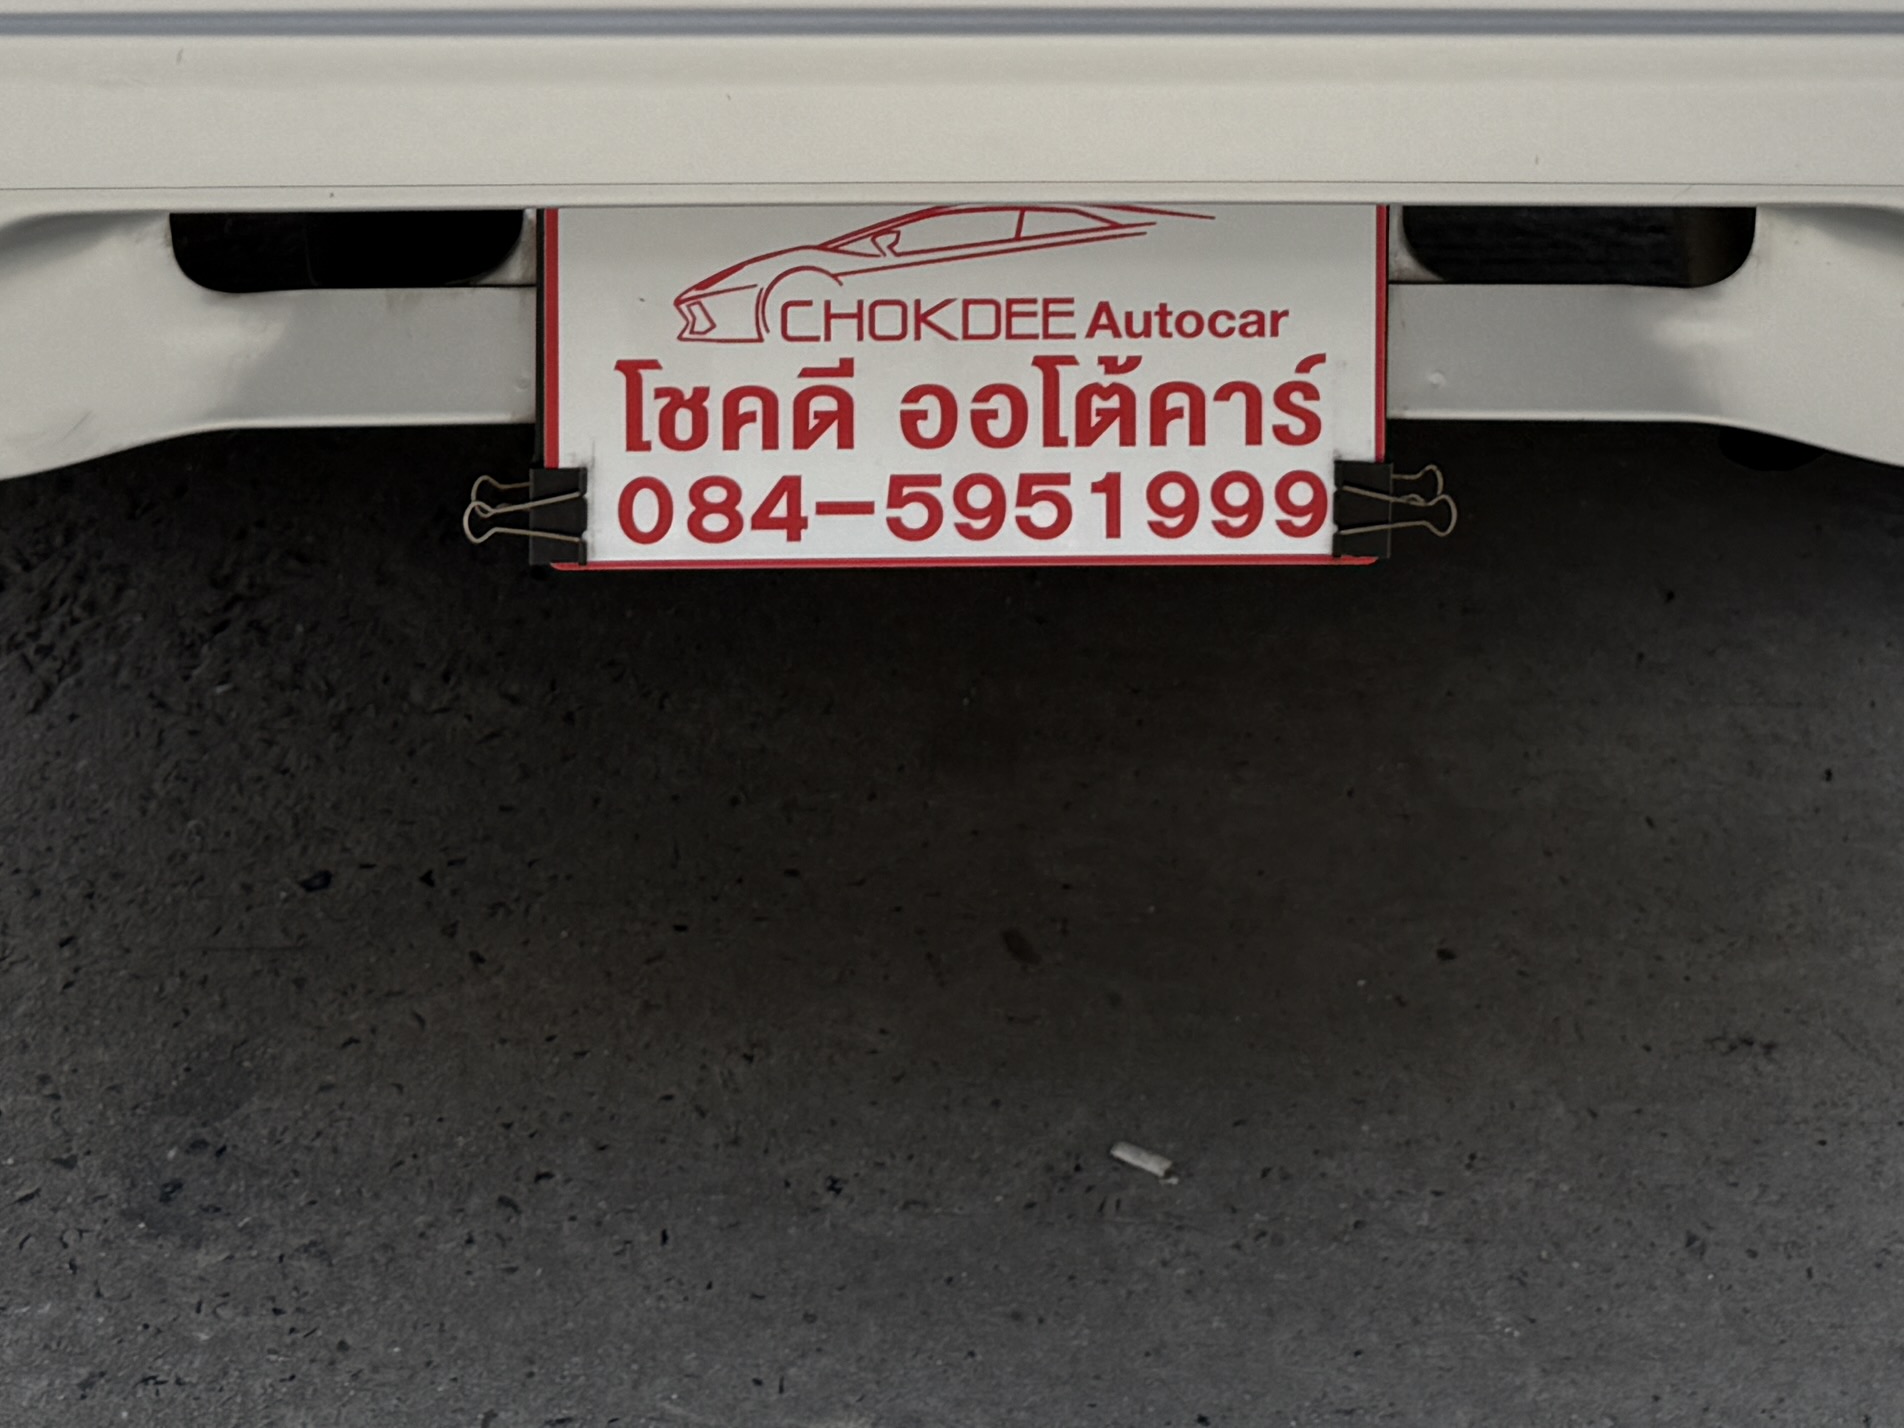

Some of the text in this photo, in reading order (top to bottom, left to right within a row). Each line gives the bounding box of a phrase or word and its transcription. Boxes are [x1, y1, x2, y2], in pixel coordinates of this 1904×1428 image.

[779, 296, 1290, 343] CHOKDEE Autocar
[613, 352, 1328, 453] โชคดี ออโต้คาร์
[616, 469, 1330, 546] 084-5951999
